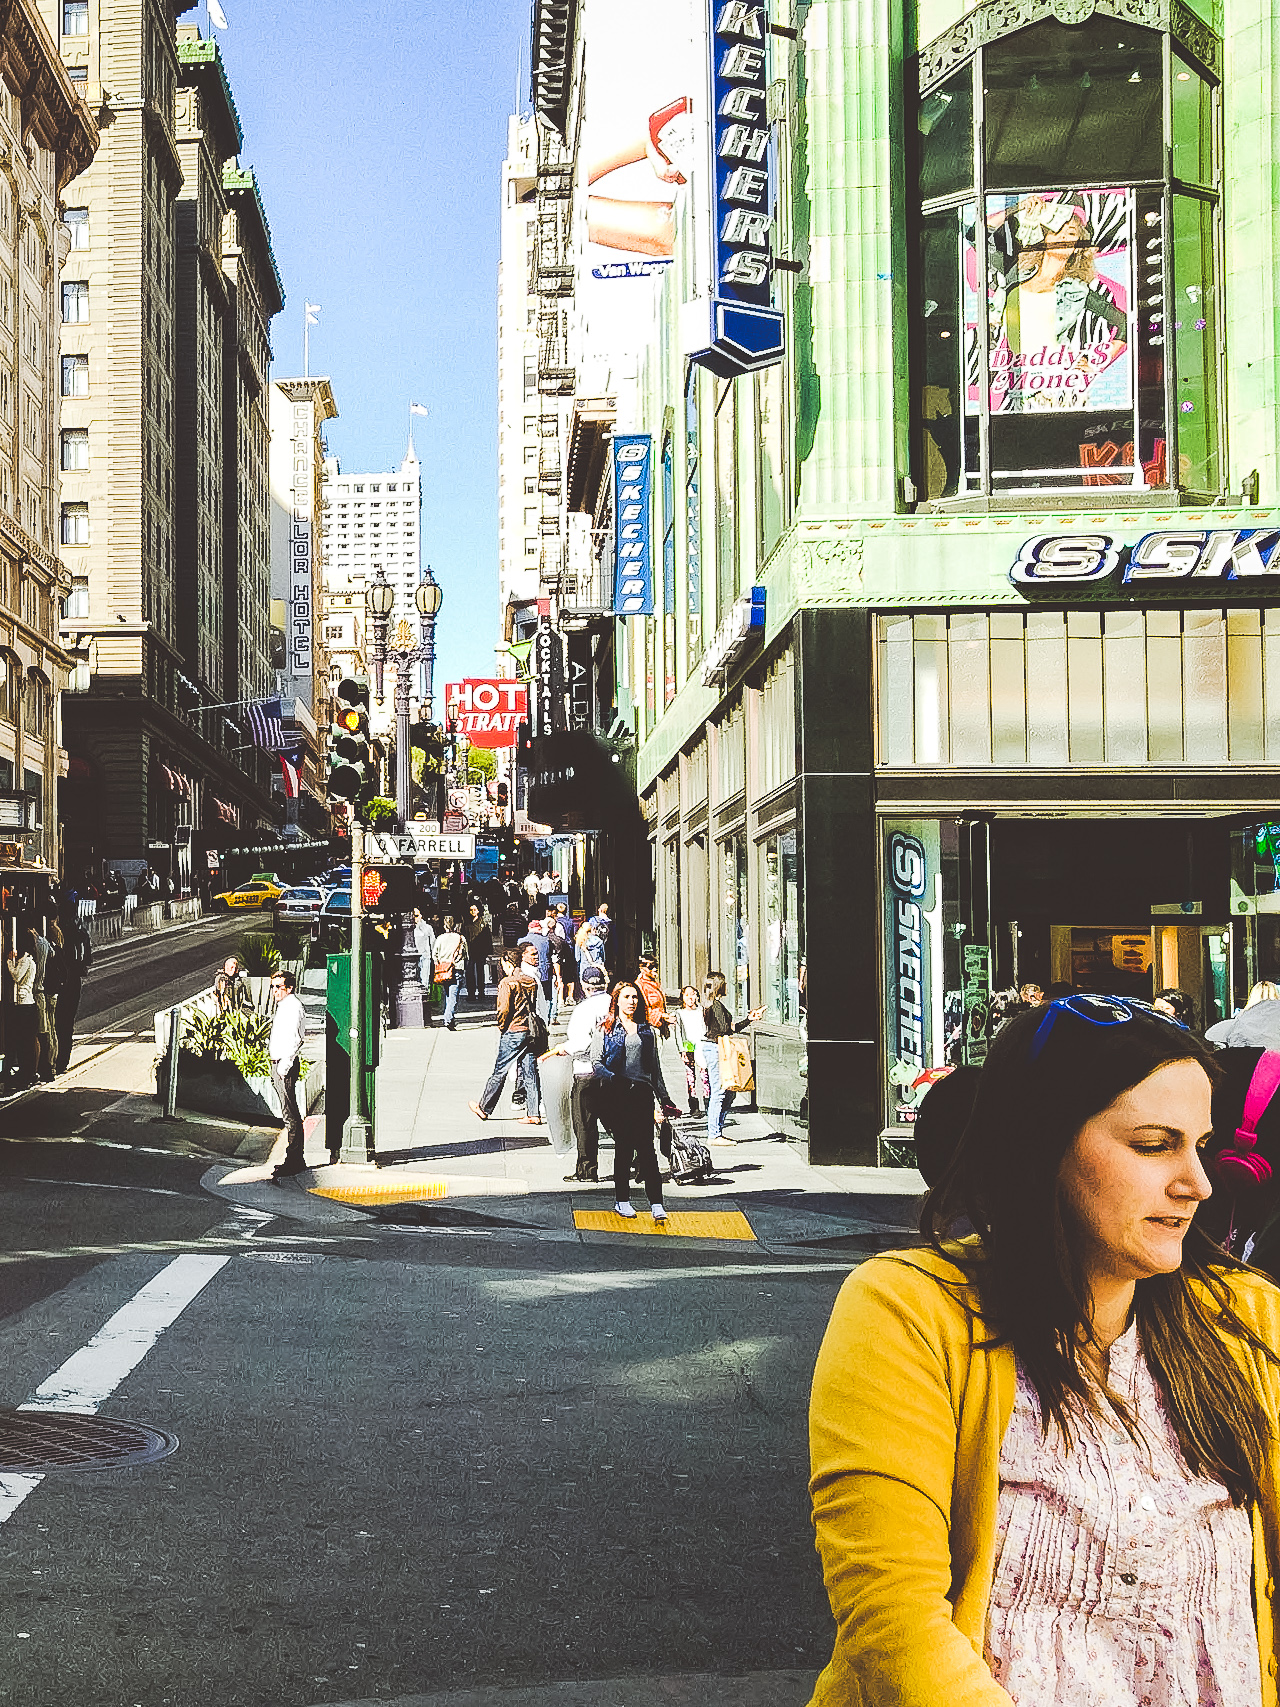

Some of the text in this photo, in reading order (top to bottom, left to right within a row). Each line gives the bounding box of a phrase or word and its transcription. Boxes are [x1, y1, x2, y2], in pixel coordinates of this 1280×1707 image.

[292, 404, 311, 669] CHANCELLOR HOTEL
[619, 465, 646, 611] SKECHERS
[1122, 528, 1280, 579] SK
[538, 623, 553, 737] COCKTAILS
[419, 823, 437, 833] 200
